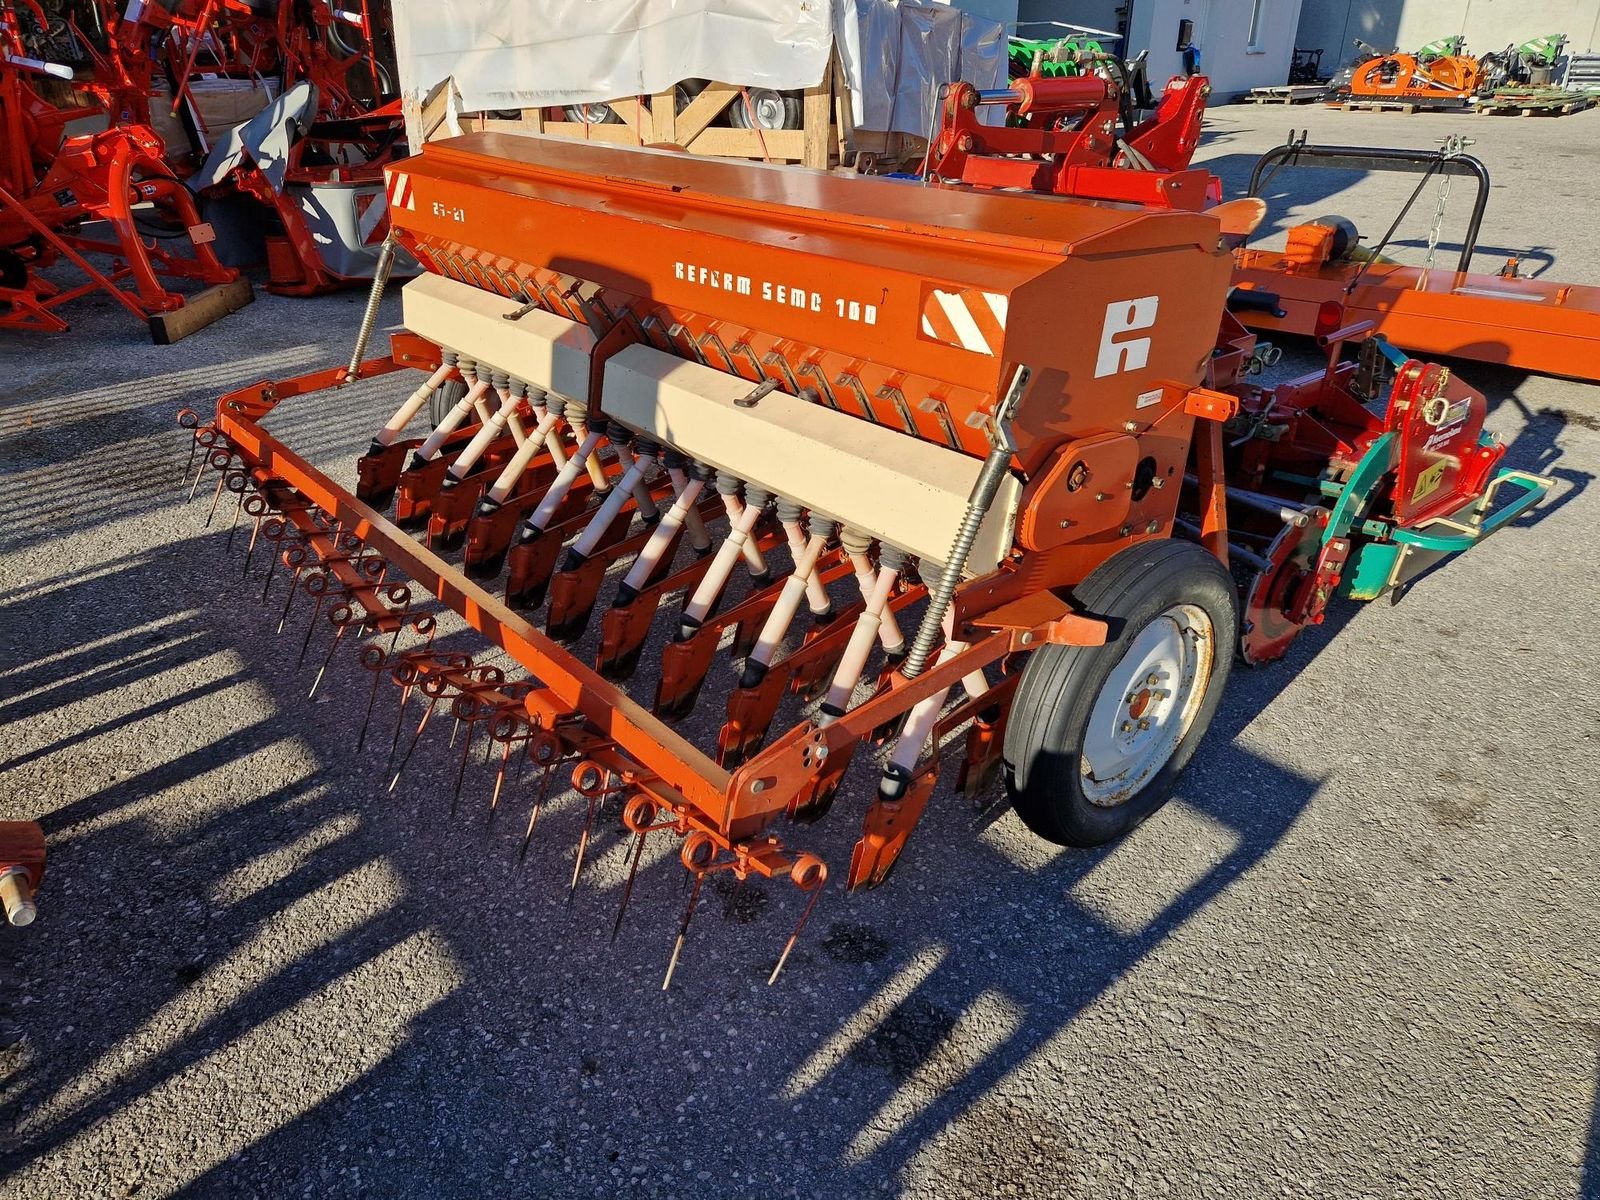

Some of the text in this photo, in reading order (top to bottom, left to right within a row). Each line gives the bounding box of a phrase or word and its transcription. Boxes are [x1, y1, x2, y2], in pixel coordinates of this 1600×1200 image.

[675, 261, 877, 325] REFORM SEMO 100
